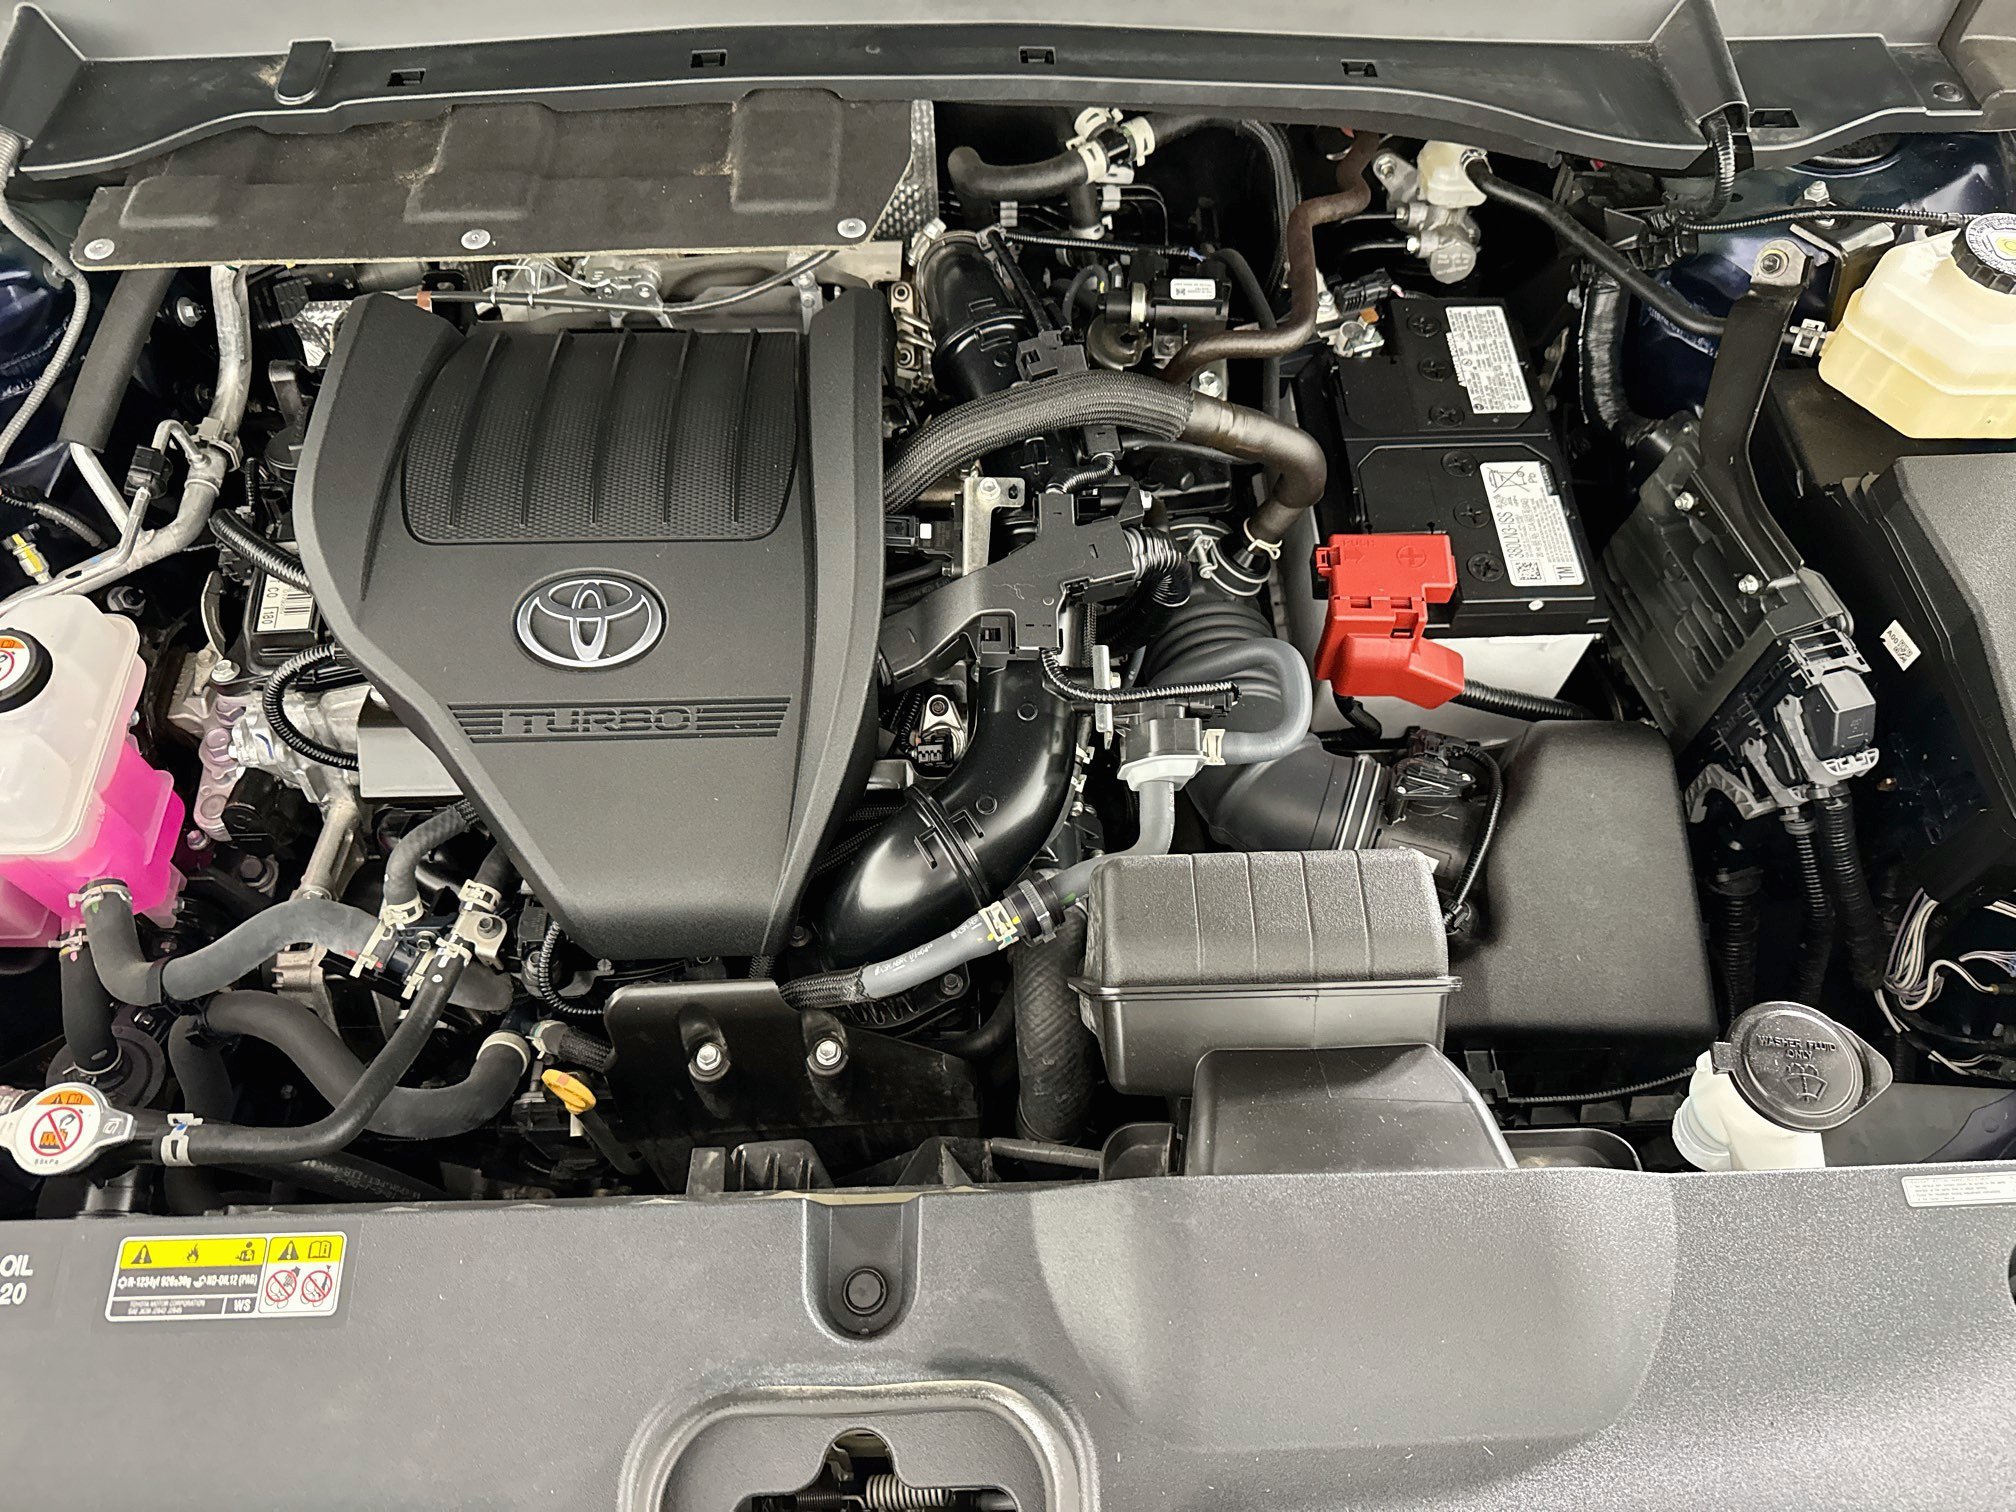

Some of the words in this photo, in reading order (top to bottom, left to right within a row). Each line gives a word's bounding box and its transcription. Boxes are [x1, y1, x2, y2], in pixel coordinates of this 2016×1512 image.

[1556, 566, 1576, 580] TM
[261, 611, 275, 625] 180
[1886, 630, 1899, 644] A00
[505, 706, 692, 735] TURBO
[1756, 1033, 1802, 1048] WASHER
[1806, 1039, 1837, 1051] FLUID
[1786, 1048, 1813, 1060] ONLY
[0, 1254, 34, 1277] OIL
[233, 1299, 251, 1312] WS
